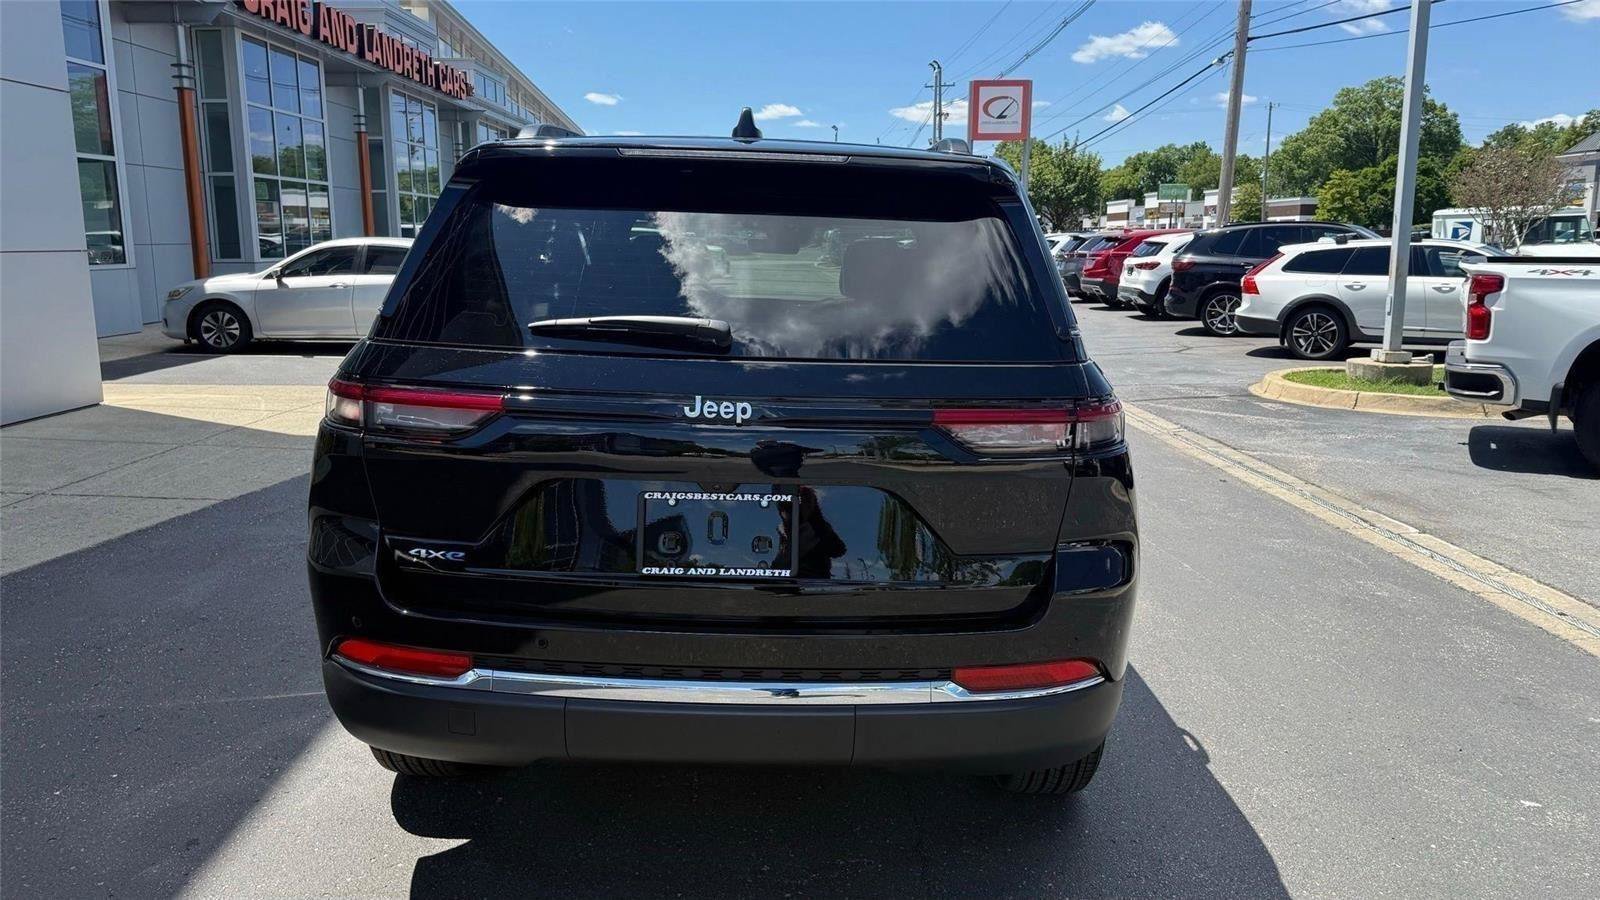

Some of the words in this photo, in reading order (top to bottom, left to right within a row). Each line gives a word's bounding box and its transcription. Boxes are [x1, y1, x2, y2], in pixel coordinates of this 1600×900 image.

[320, 2, 357, 55] AND
[363, 22, 436, 89] LANDRETH
[439, 61, 467, 101] CARS
[683, 395, 753, 424] Jeep
[643, 491, 792, 502] CRAIGSBESTCARS.COM
[641, 566, 684, 576] CRAIG
[686, 567, 717, 576] AND
[719, 567, 791, 577] LANDRETH
